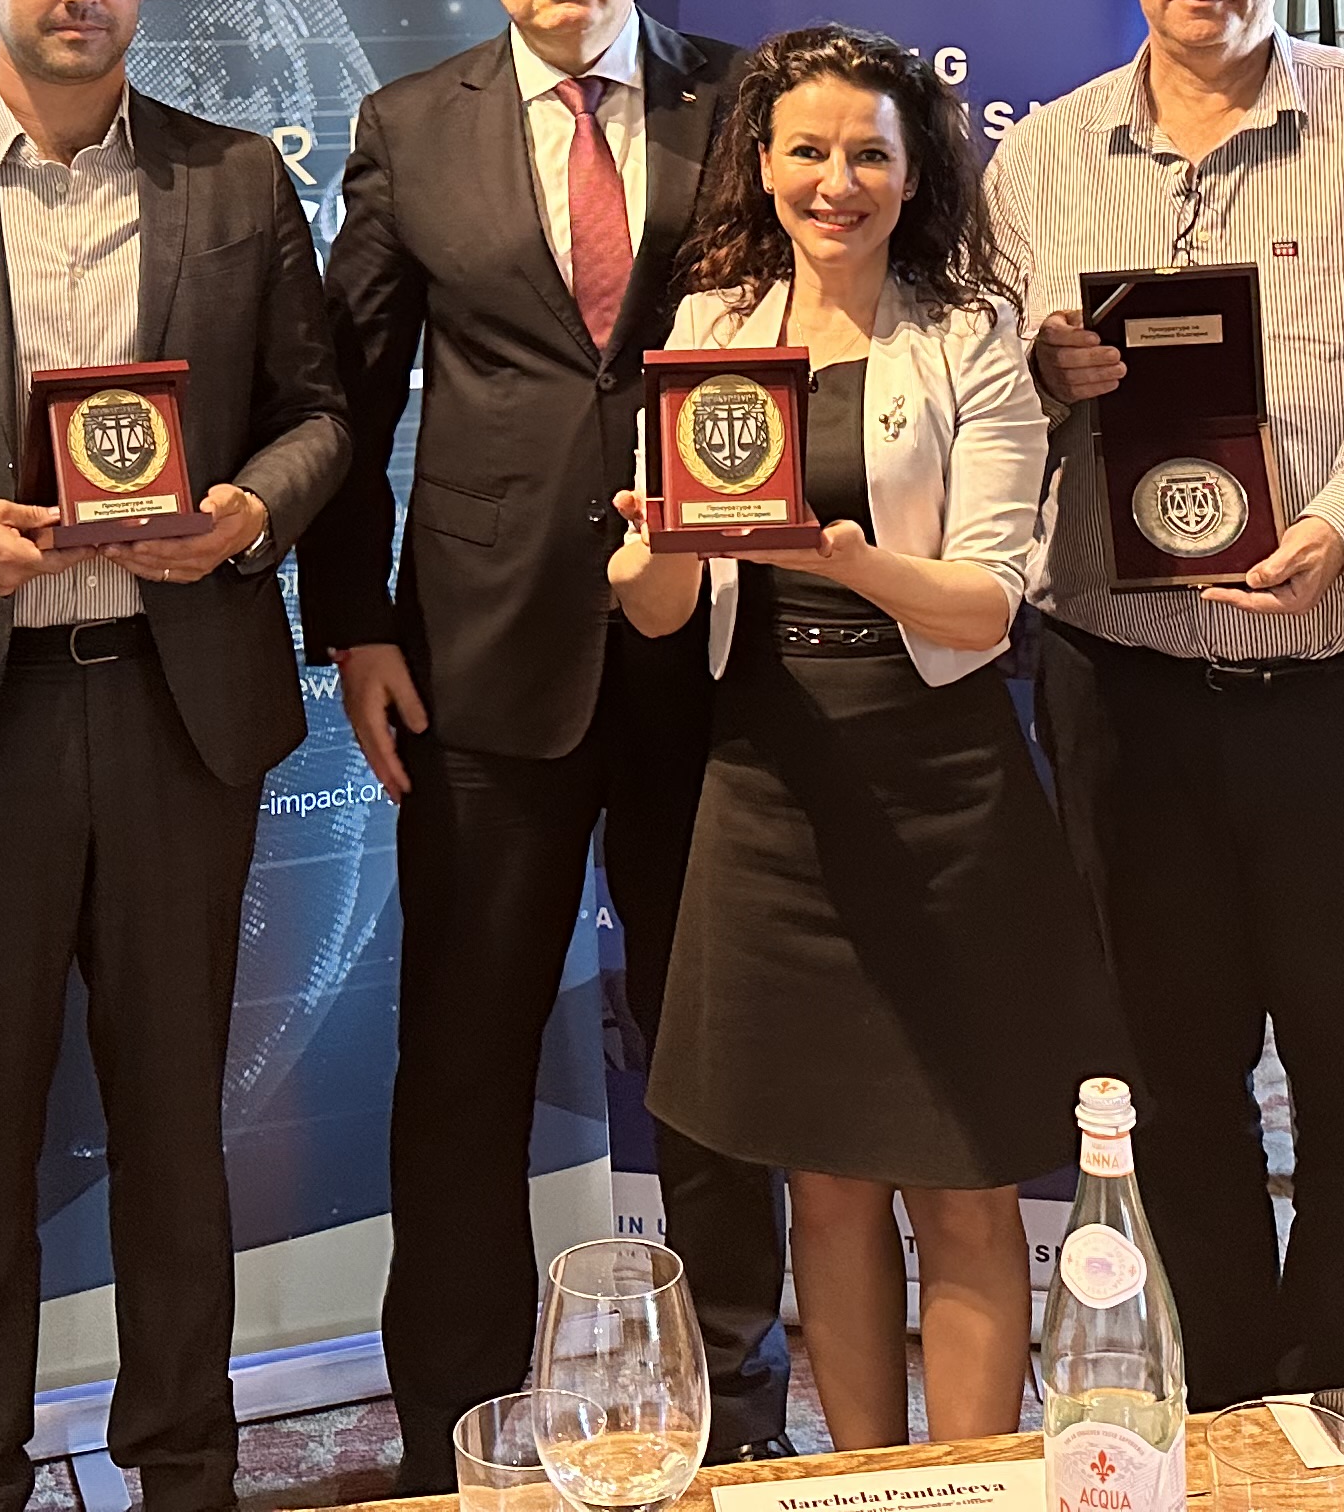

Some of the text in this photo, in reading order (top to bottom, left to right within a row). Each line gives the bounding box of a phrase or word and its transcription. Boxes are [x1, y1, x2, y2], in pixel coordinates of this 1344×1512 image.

[260, 780, 394, 817] -impact.or
[1083, 1150, 1120, 1169] ANNA
[618, 1215, 643, 1234] IN
[778, 1482, 1008, 1511] Marchela Pantaleeva
[1080, 1487, 1132, 1510] ACQUA
